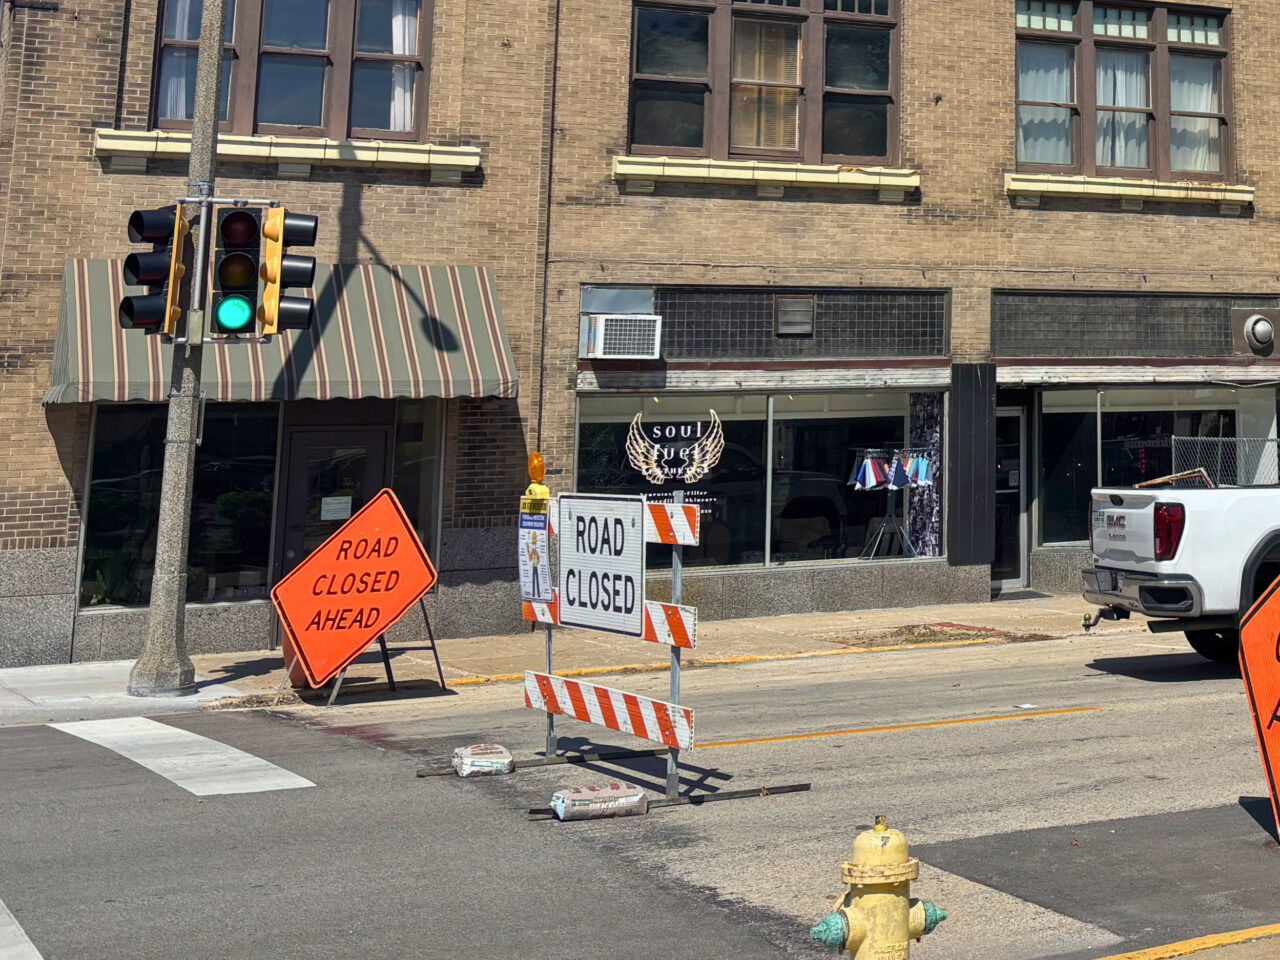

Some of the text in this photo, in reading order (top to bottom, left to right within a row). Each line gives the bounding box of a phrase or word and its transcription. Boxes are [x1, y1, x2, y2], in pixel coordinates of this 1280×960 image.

[652, 421, 702, 438] soul
[336, 536, 399, 561] ROAD
[576, 515, 625, 557] ROAD
[312, 570, 400, 596] CLOSED
[566, 568, 635, 615] CLOSED
[305, 607, 381, 632] AHEAD
